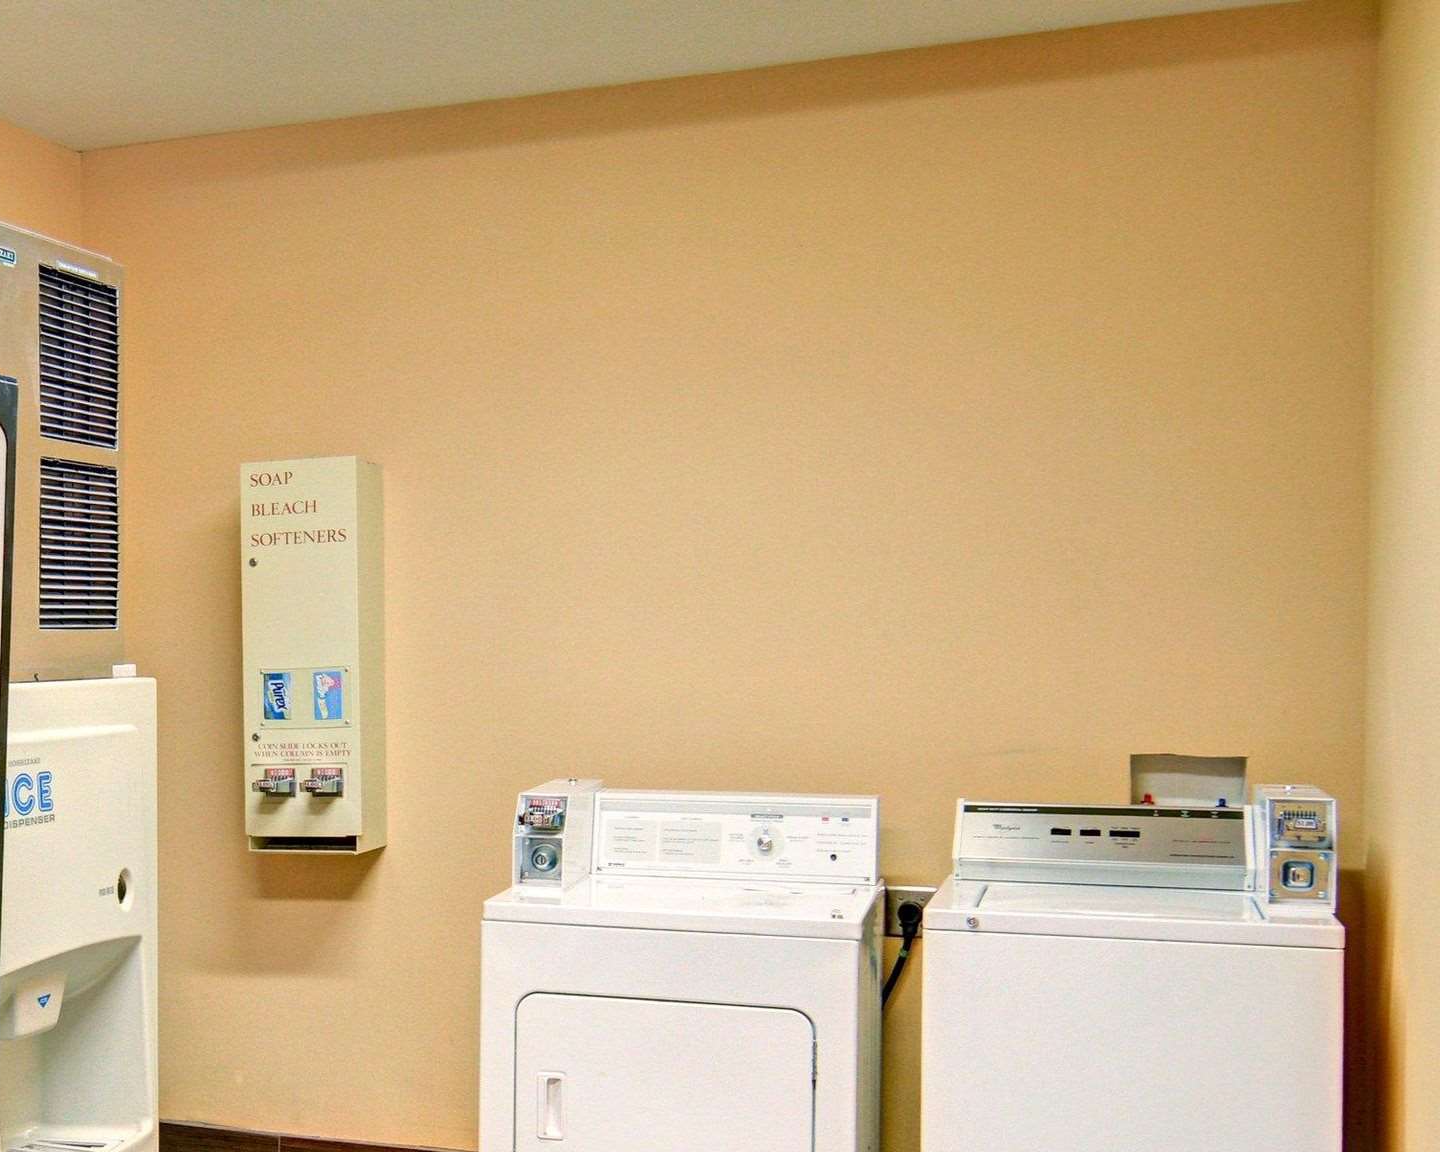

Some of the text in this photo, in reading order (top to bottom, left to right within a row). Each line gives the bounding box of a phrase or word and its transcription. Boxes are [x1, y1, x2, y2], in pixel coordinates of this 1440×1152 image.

[250, 471, 293, 487] SOAP
[251, 500, 317, 517] BLEACH
[251, 528, 347, 547] SOFTENERS
[270, 681, 288, 711] Purex
